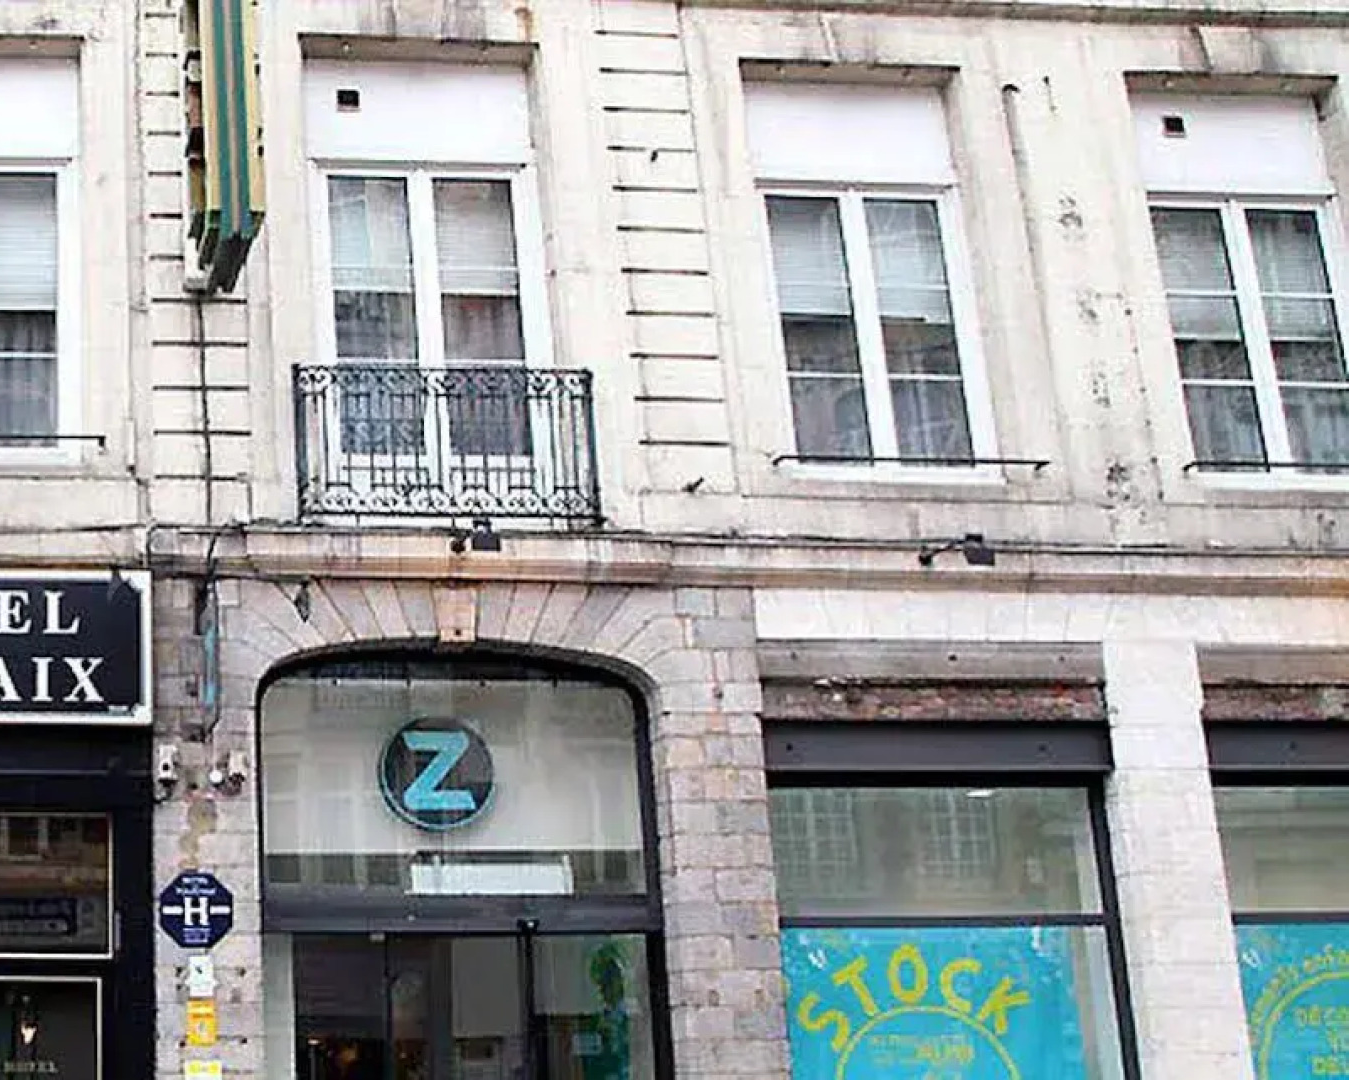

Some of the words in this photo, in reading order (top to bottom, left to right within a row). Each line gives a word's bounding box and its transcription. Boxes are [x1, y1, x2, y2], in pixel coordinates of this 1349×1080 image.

[401, 729, 477, 811] Z
[184, 896, 210, 926] H
[797, 944, 1031, 1051] STOCK
